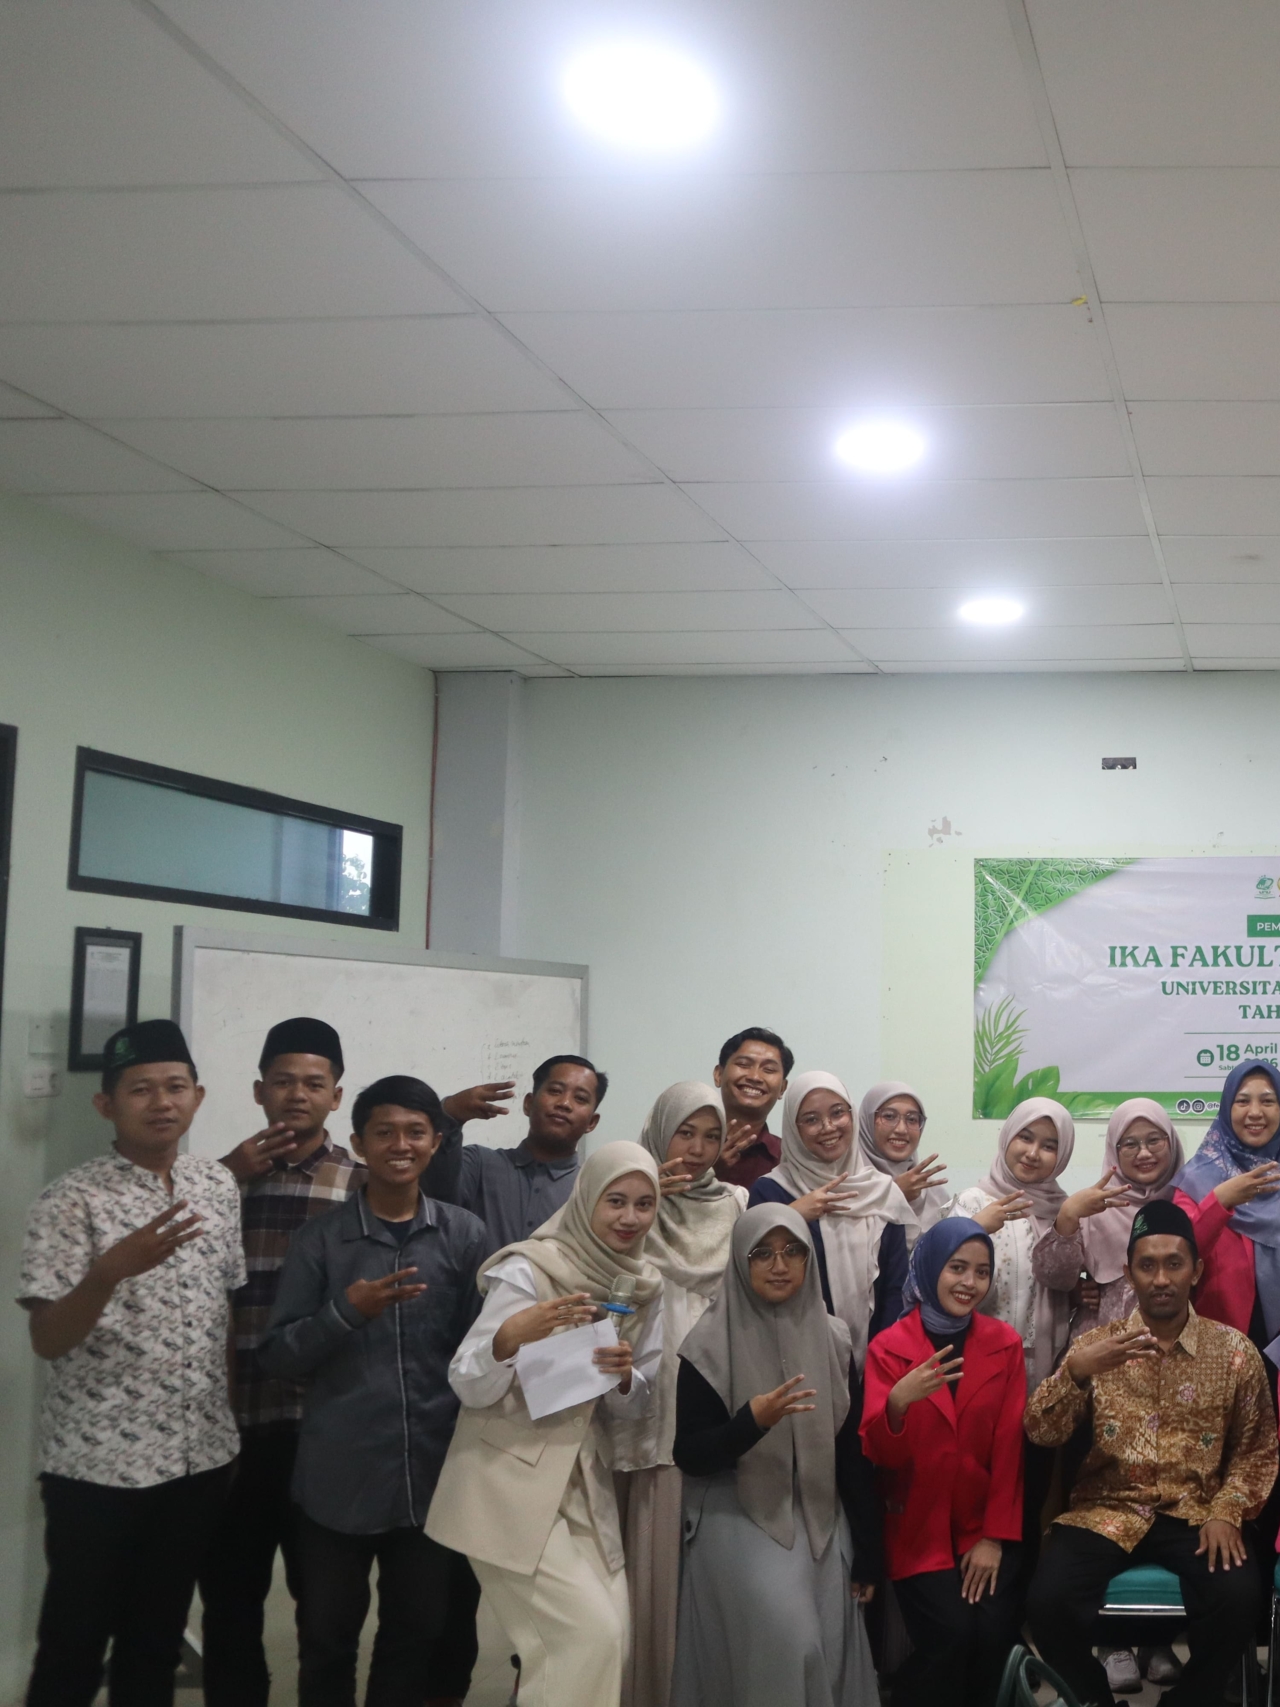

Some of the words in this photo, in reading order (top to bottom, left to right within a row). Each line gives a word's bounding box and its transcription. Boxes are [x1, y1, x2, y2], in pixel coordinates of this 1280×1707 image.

[1108, 945, 1163, 968] IKA
[1216, 1044, 1241, 1061] 18
[1244, 1042, 1278, 1056] April
